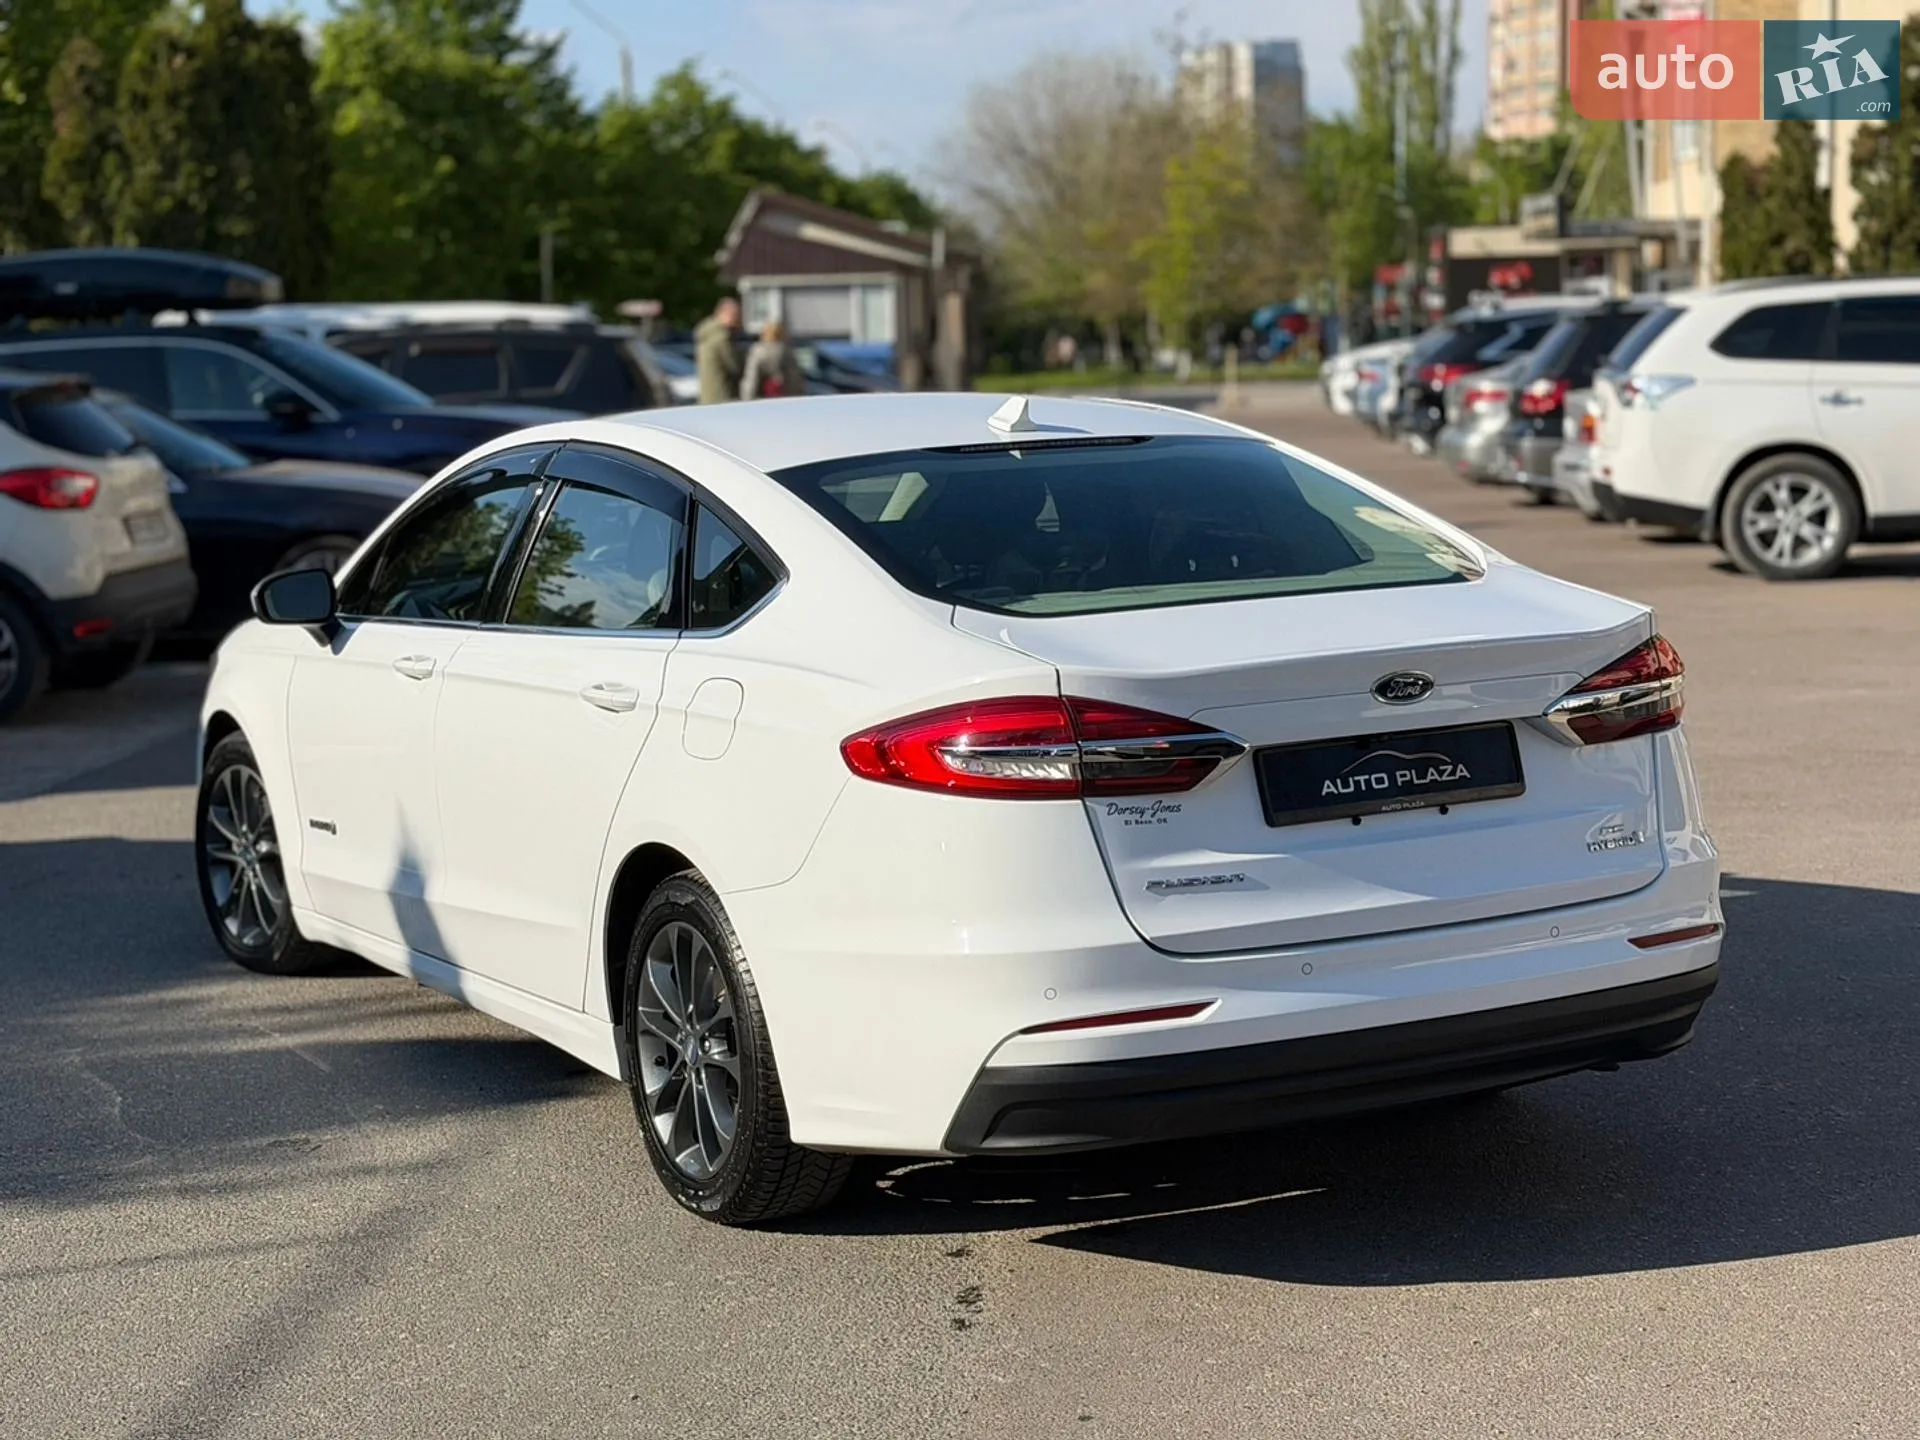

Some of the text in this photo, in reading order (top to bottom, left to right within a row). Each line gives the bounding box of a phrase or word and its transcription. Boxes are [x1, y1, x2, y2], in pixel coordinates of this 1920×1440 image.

[1321, 763, 1471, 796] AUTO PLAZA
[1381, 800, 1425, 811] AUTO PLAZA
